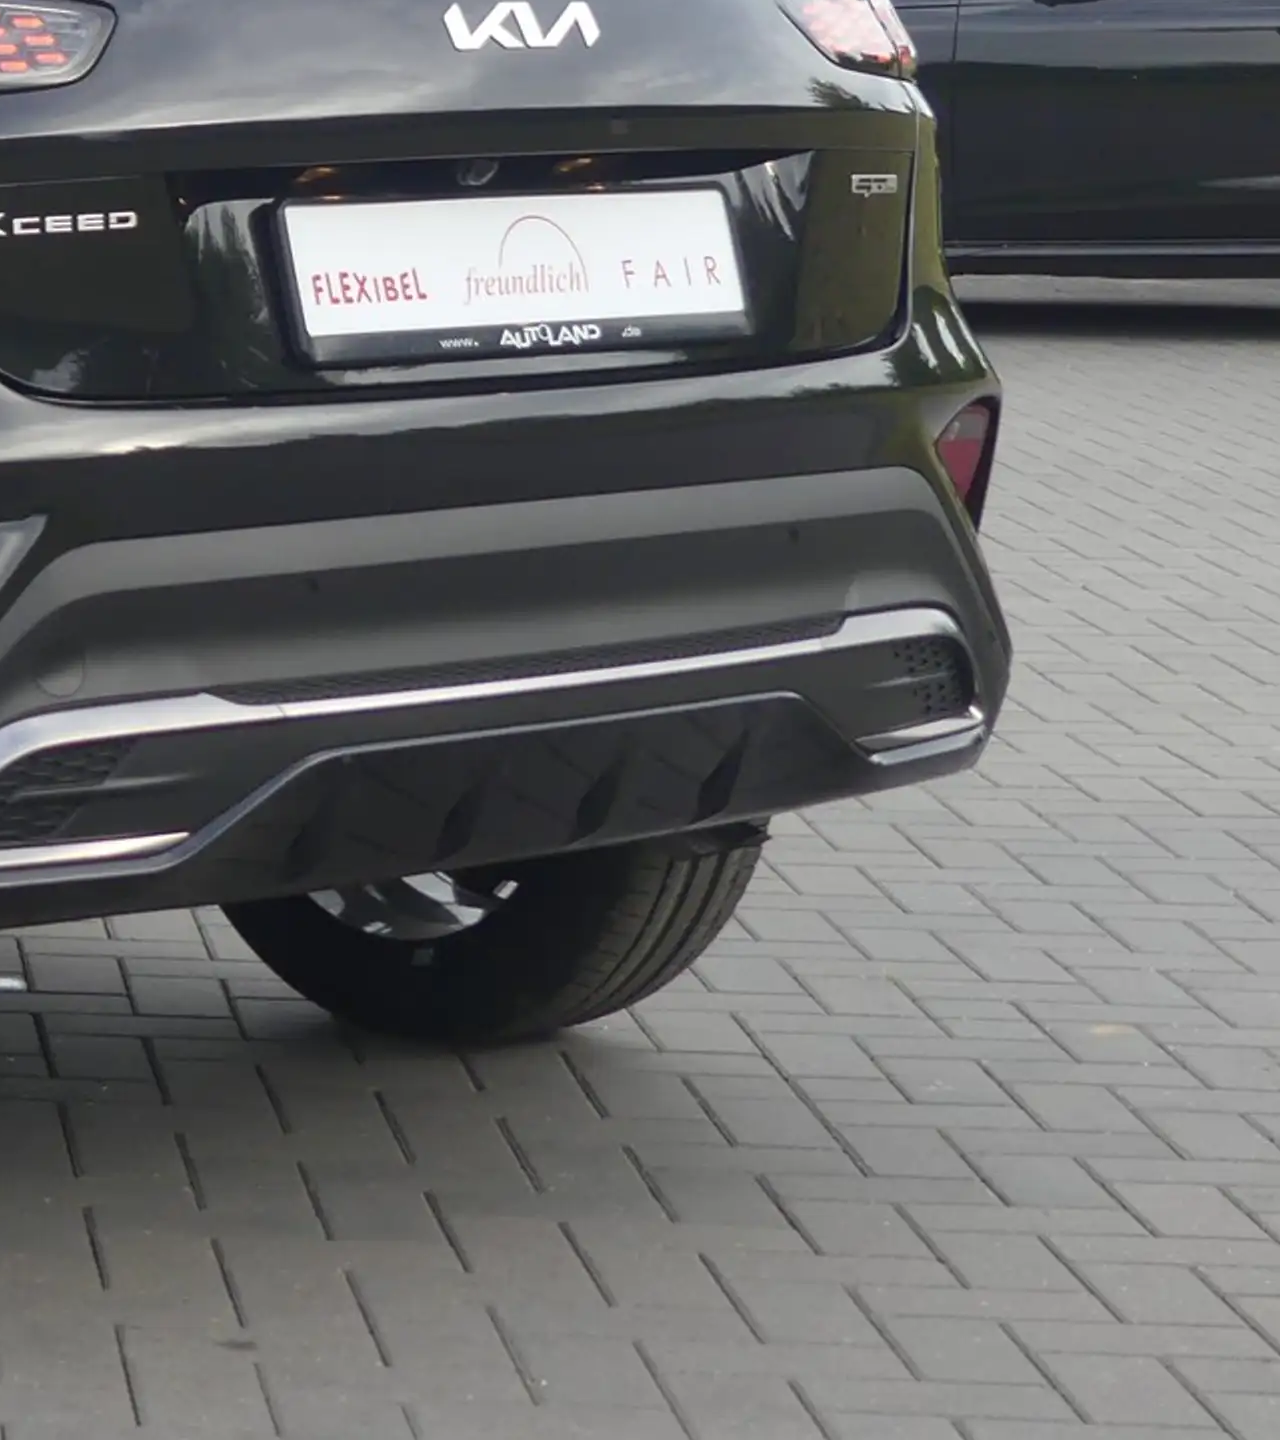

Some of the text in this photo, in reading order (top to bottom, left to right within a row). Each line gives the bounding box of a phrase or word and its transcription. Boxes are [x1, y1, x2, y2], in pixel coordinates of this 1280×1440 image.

[443, 1, 601, 51] KIA
[311, 256, 722, 306] FLEXIBEL freundlich FAIR
[500, 323, 602, 349] AUTOLAND
